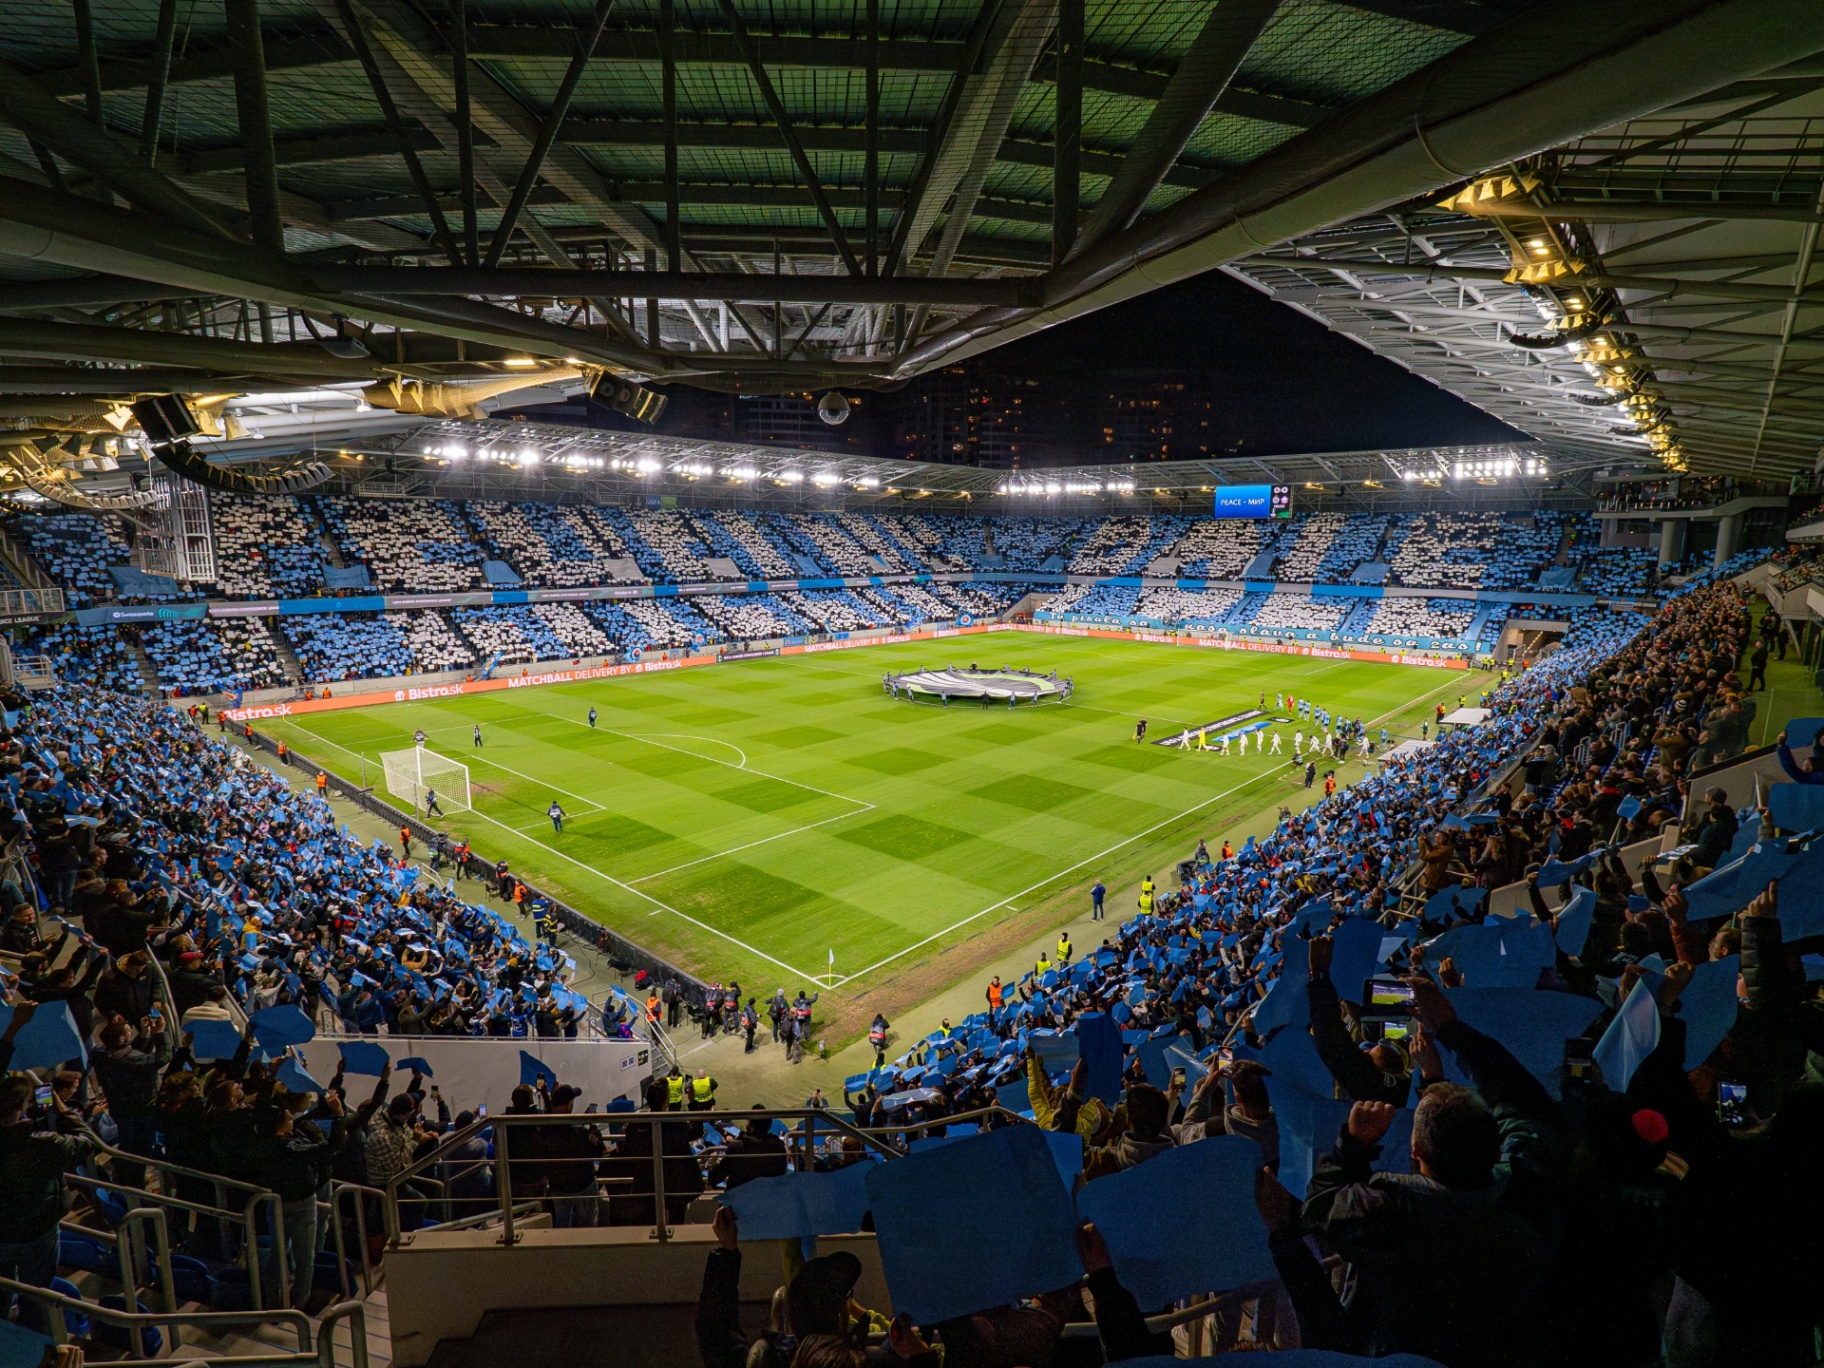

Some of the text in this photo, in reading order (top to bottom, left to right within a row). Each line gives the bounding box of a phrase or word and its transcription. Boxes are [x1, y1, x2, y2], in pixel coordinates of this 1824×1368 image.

[987, 623, 1016, 632] MATCHBALL
[1018, 625, 1044, 633] DELIVERY
[805, 642, 842, 652] MATCHBALL
[844, 638, 870, 648] DELIVERY
[1329, 631, 1384, 645] bude
[1200, 638, 1351, 659] MATCHBALL DELIVERY BY Bistro.sk
[1402, 655, 1447, 668] Bistro.sk
[508, 659, 682, 688] MATCHBALL DELIVERY BY Bistro.sk
[409, 684, 464, 700] Bistro.sk
